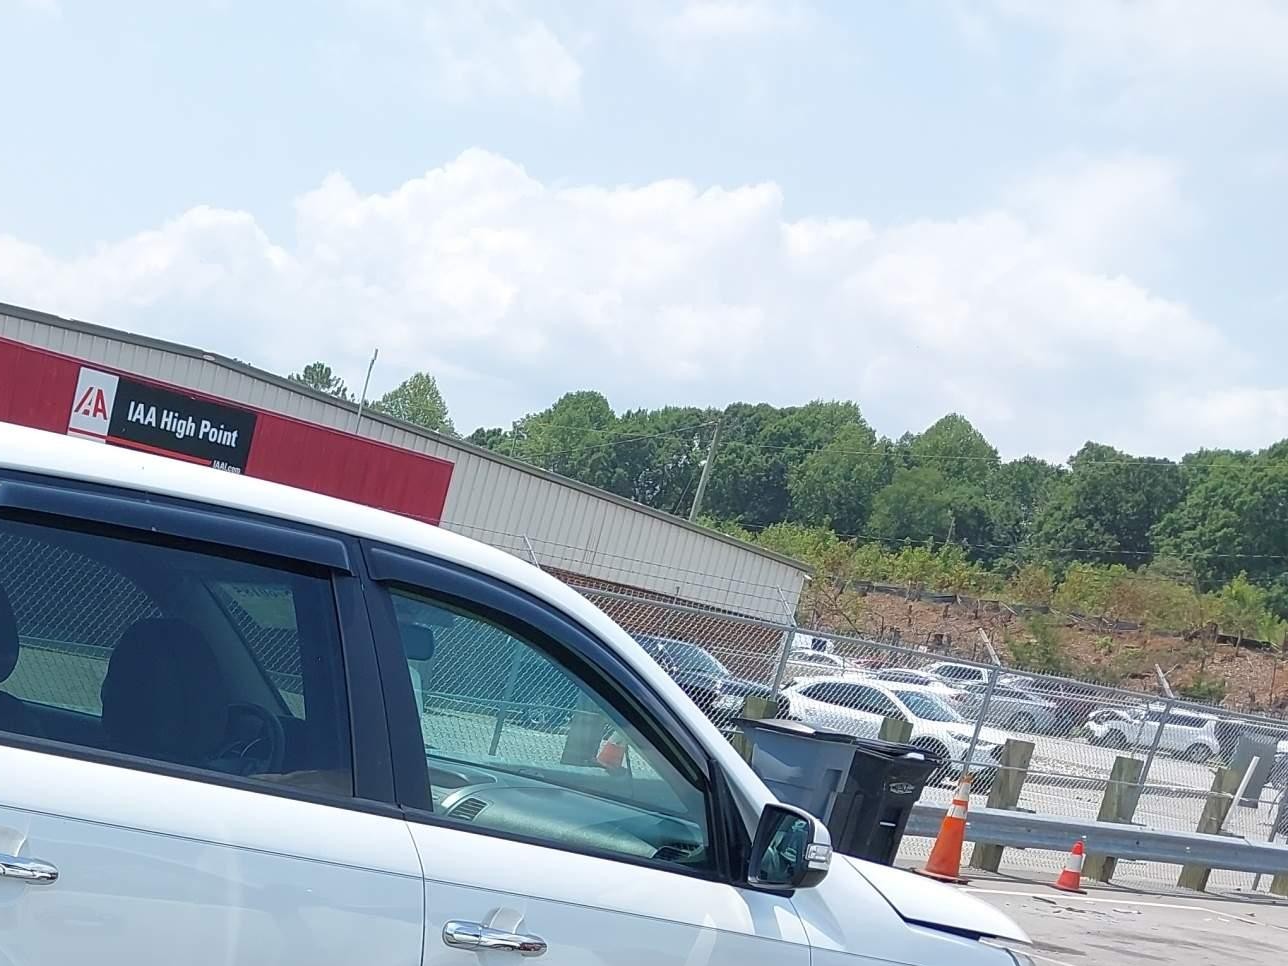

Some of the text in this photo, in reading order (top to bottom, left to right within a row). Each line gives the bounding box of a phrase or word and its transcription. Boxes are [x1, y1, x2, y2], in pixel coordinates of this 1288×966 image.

[127, 401, 239, 448] IAA High Point
